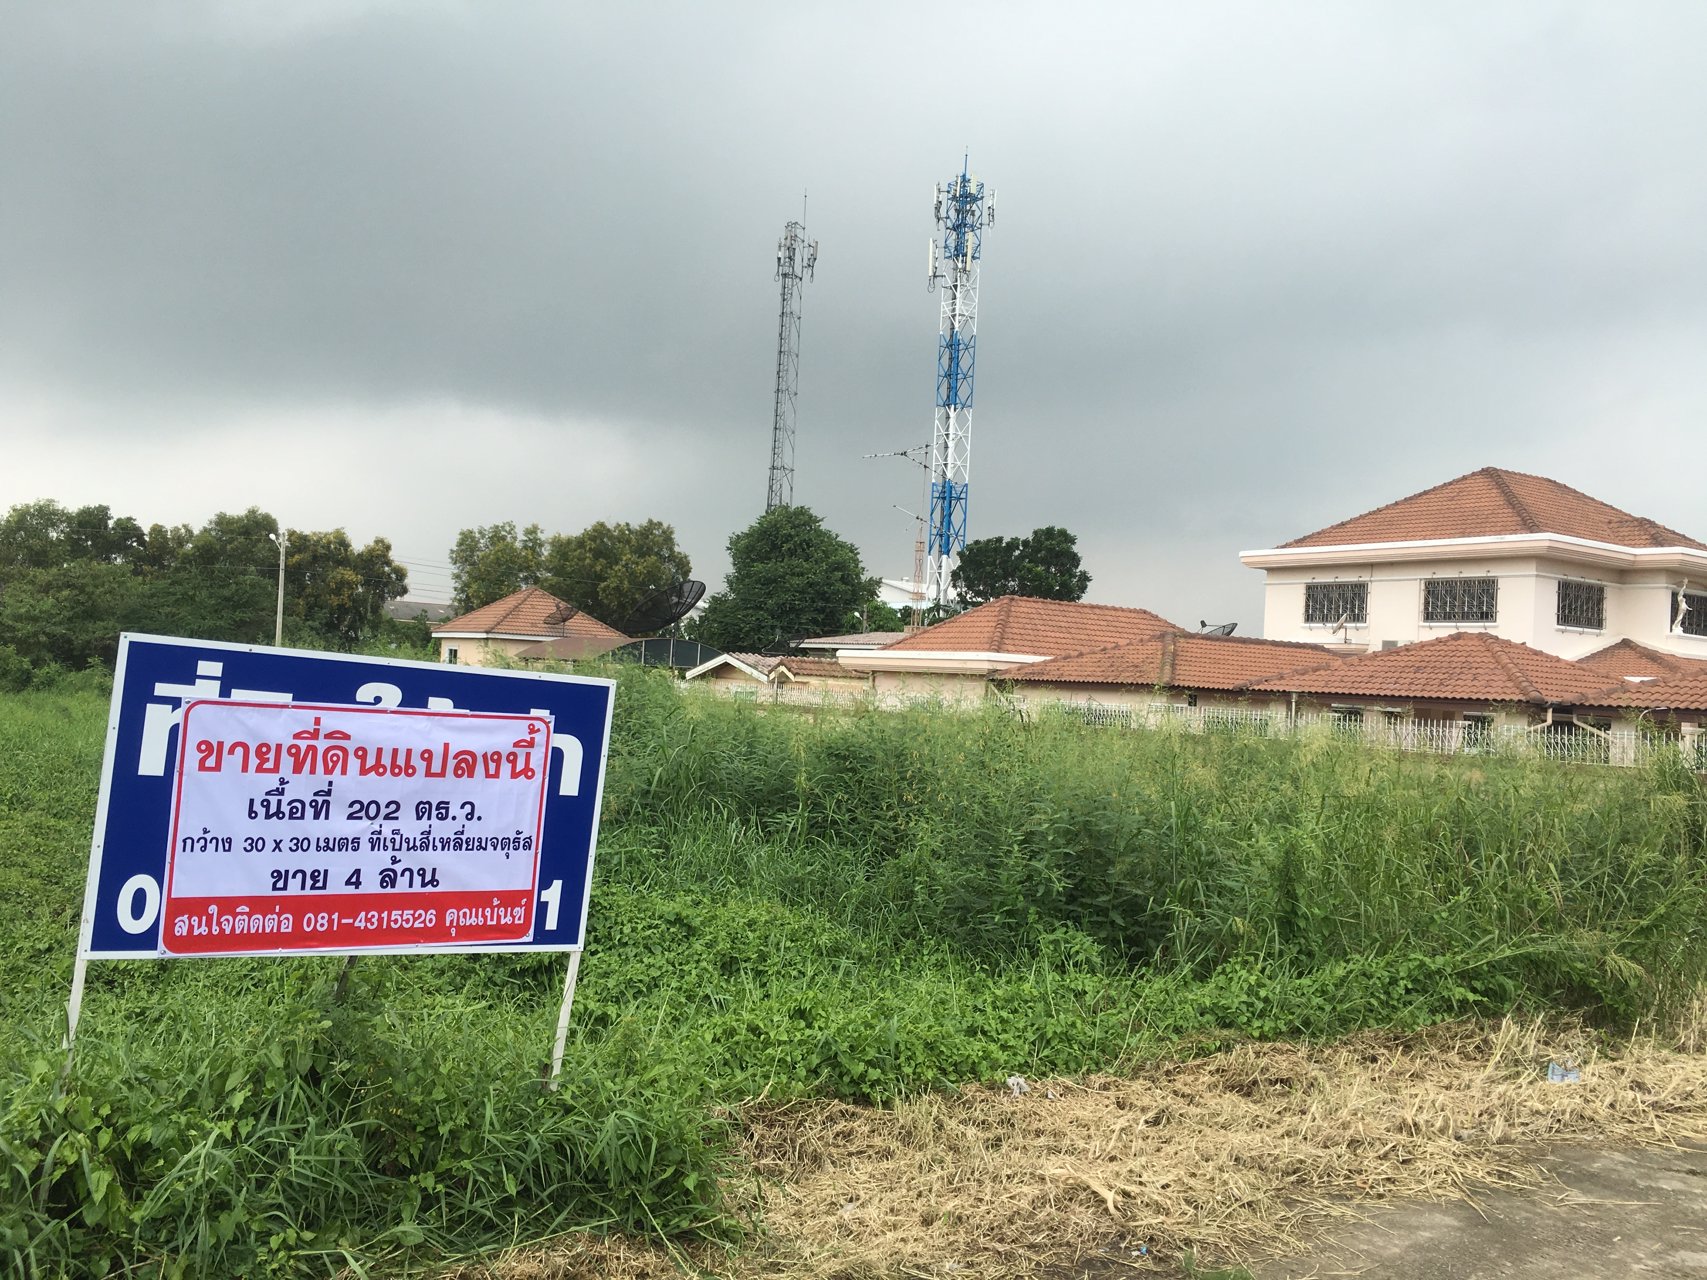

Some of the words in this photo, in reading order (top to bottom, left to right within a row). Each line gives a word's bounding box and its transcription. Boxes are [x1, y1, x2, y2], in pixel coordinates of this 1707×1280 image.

[196, 717, 541, 781] ขายที่ดินแปลงนี้
[248, 777, 333, 822] เนื้อที่
[347, 799, 401, 822] 202
[414, 799, 483, 822] ตร.ว.
[182, 827, 233, 853] กว้าง
[243, 837, 266, 853] 30
[288, 837, 311, 853] 30
[315, 837, 361, 853] เมตร
[368, 824, 533, 860] ที่เป็นสี่เหลี่ยมจตุรัส
[270, 868, 329, 891] ขาย
[344, 868, 362, 890] 4
[378, 855, 440, 890] ล้าน
[173, 904, 293, 937] สนใจติดต่อ
[303, 909, 437, 932] 081-4315526
